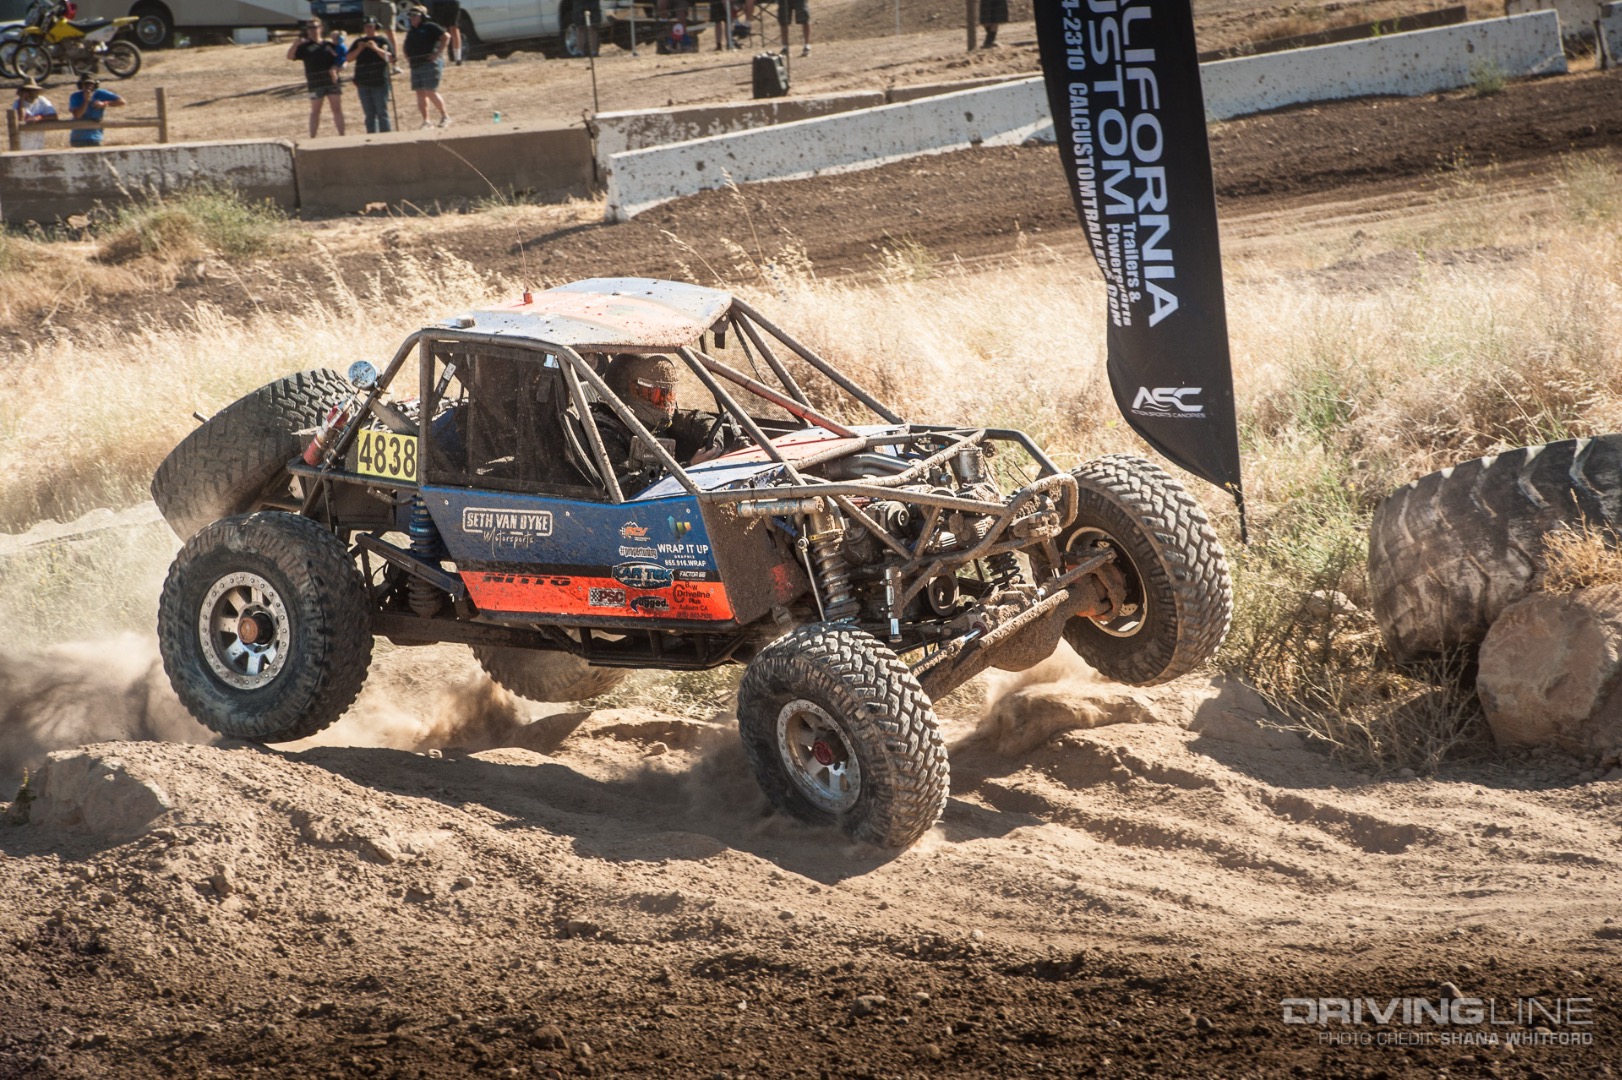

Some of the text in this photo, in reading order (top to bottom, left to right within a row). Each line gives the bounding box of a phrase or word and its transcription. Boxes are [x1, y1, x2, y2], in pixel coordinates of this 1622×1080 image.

[1120, 0, 1179, 327] LIFORNIA
[1123, 221, 1142, 303] Trailers &
[1131, 386, 1204, 412] ASC
[359, 433, 415, 478] 4838
[466, 512, 548, 531] SETH VAN DYKE
[657, 543, 709, 554] WRAP IT UP
[598, 590, 624, 603] PSC
